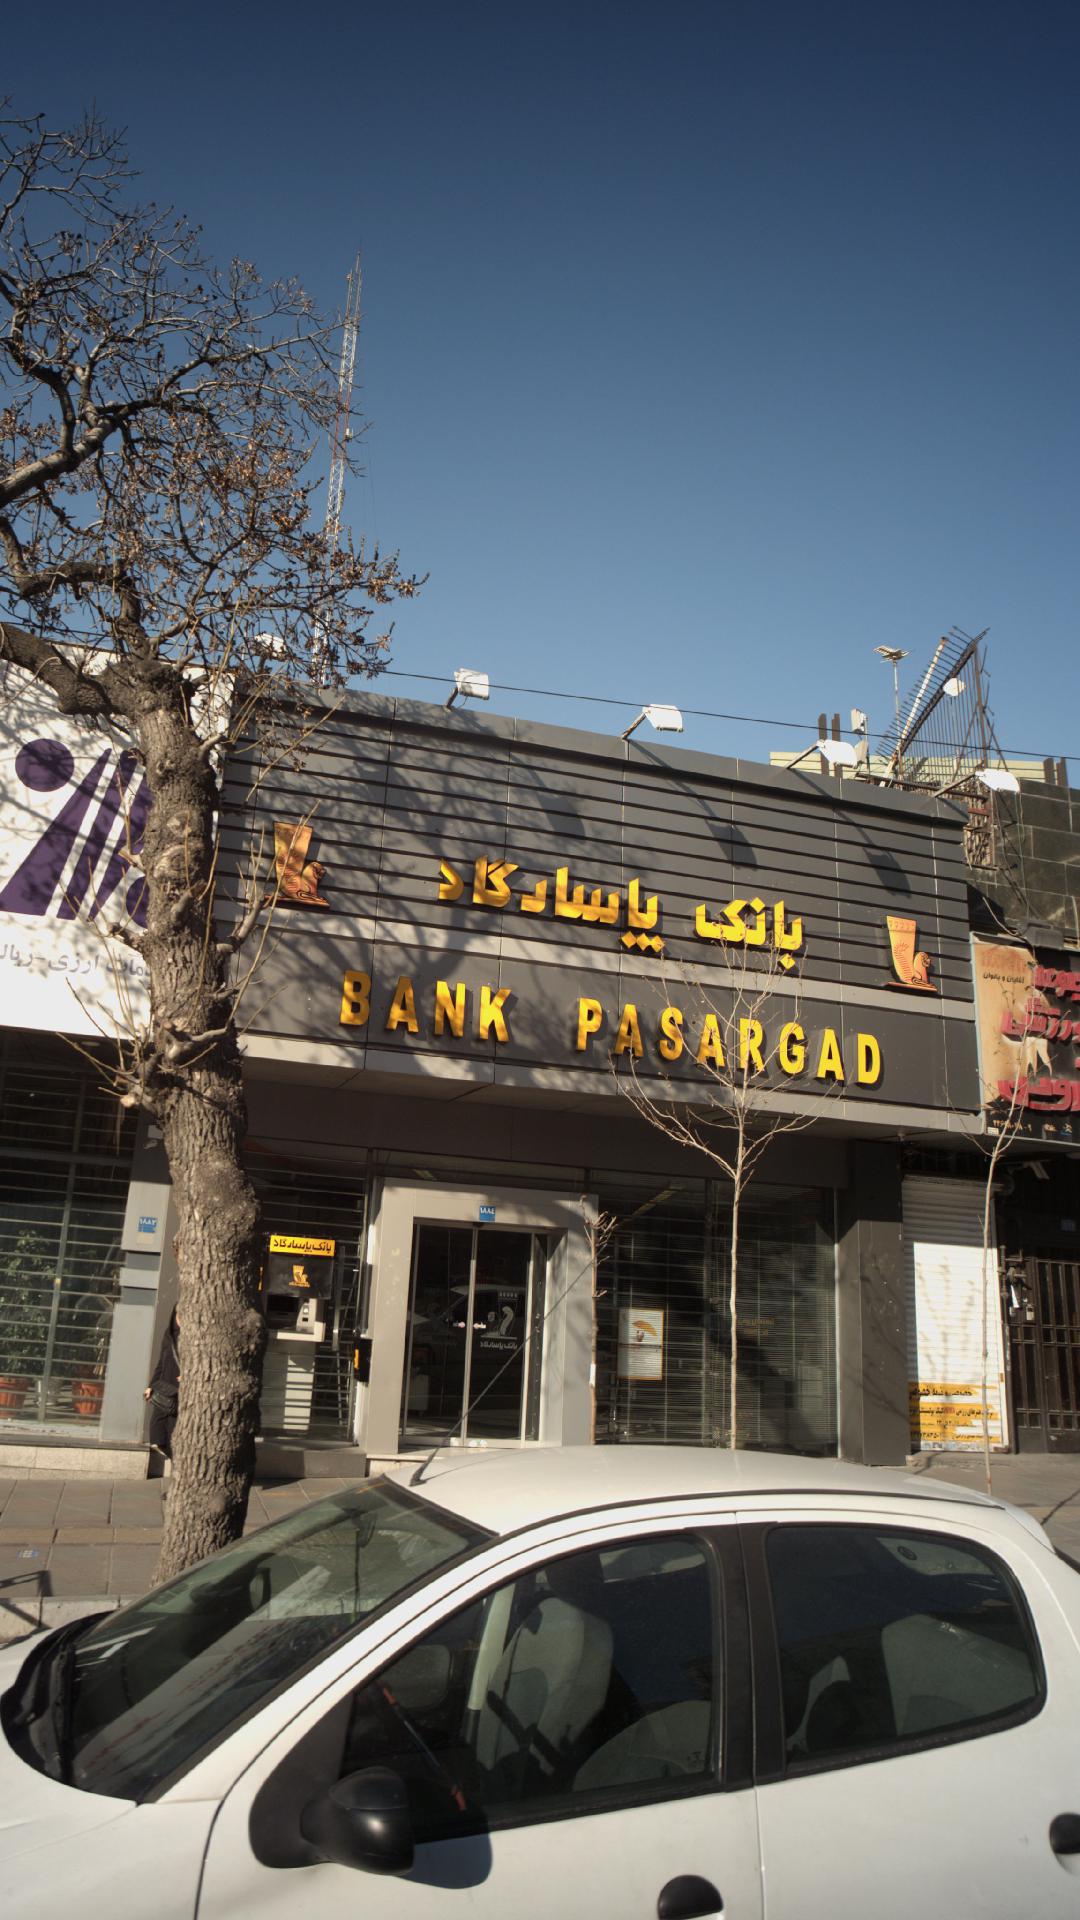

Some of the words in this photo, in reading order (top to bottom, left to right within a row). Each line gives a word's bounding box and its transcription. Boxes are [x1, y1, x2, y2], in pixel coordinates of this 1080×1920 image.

[438, 854, 665, 953] پاسارگاد
[695, 897, 803, 970] بانک
[338, 969, 511, 1042] BANK
[575, 997, 882, 1085] PASARGAD
[273, 1238, 313, 1253] پاسارگاد
[312, 1241, 332, 1254] بانک
